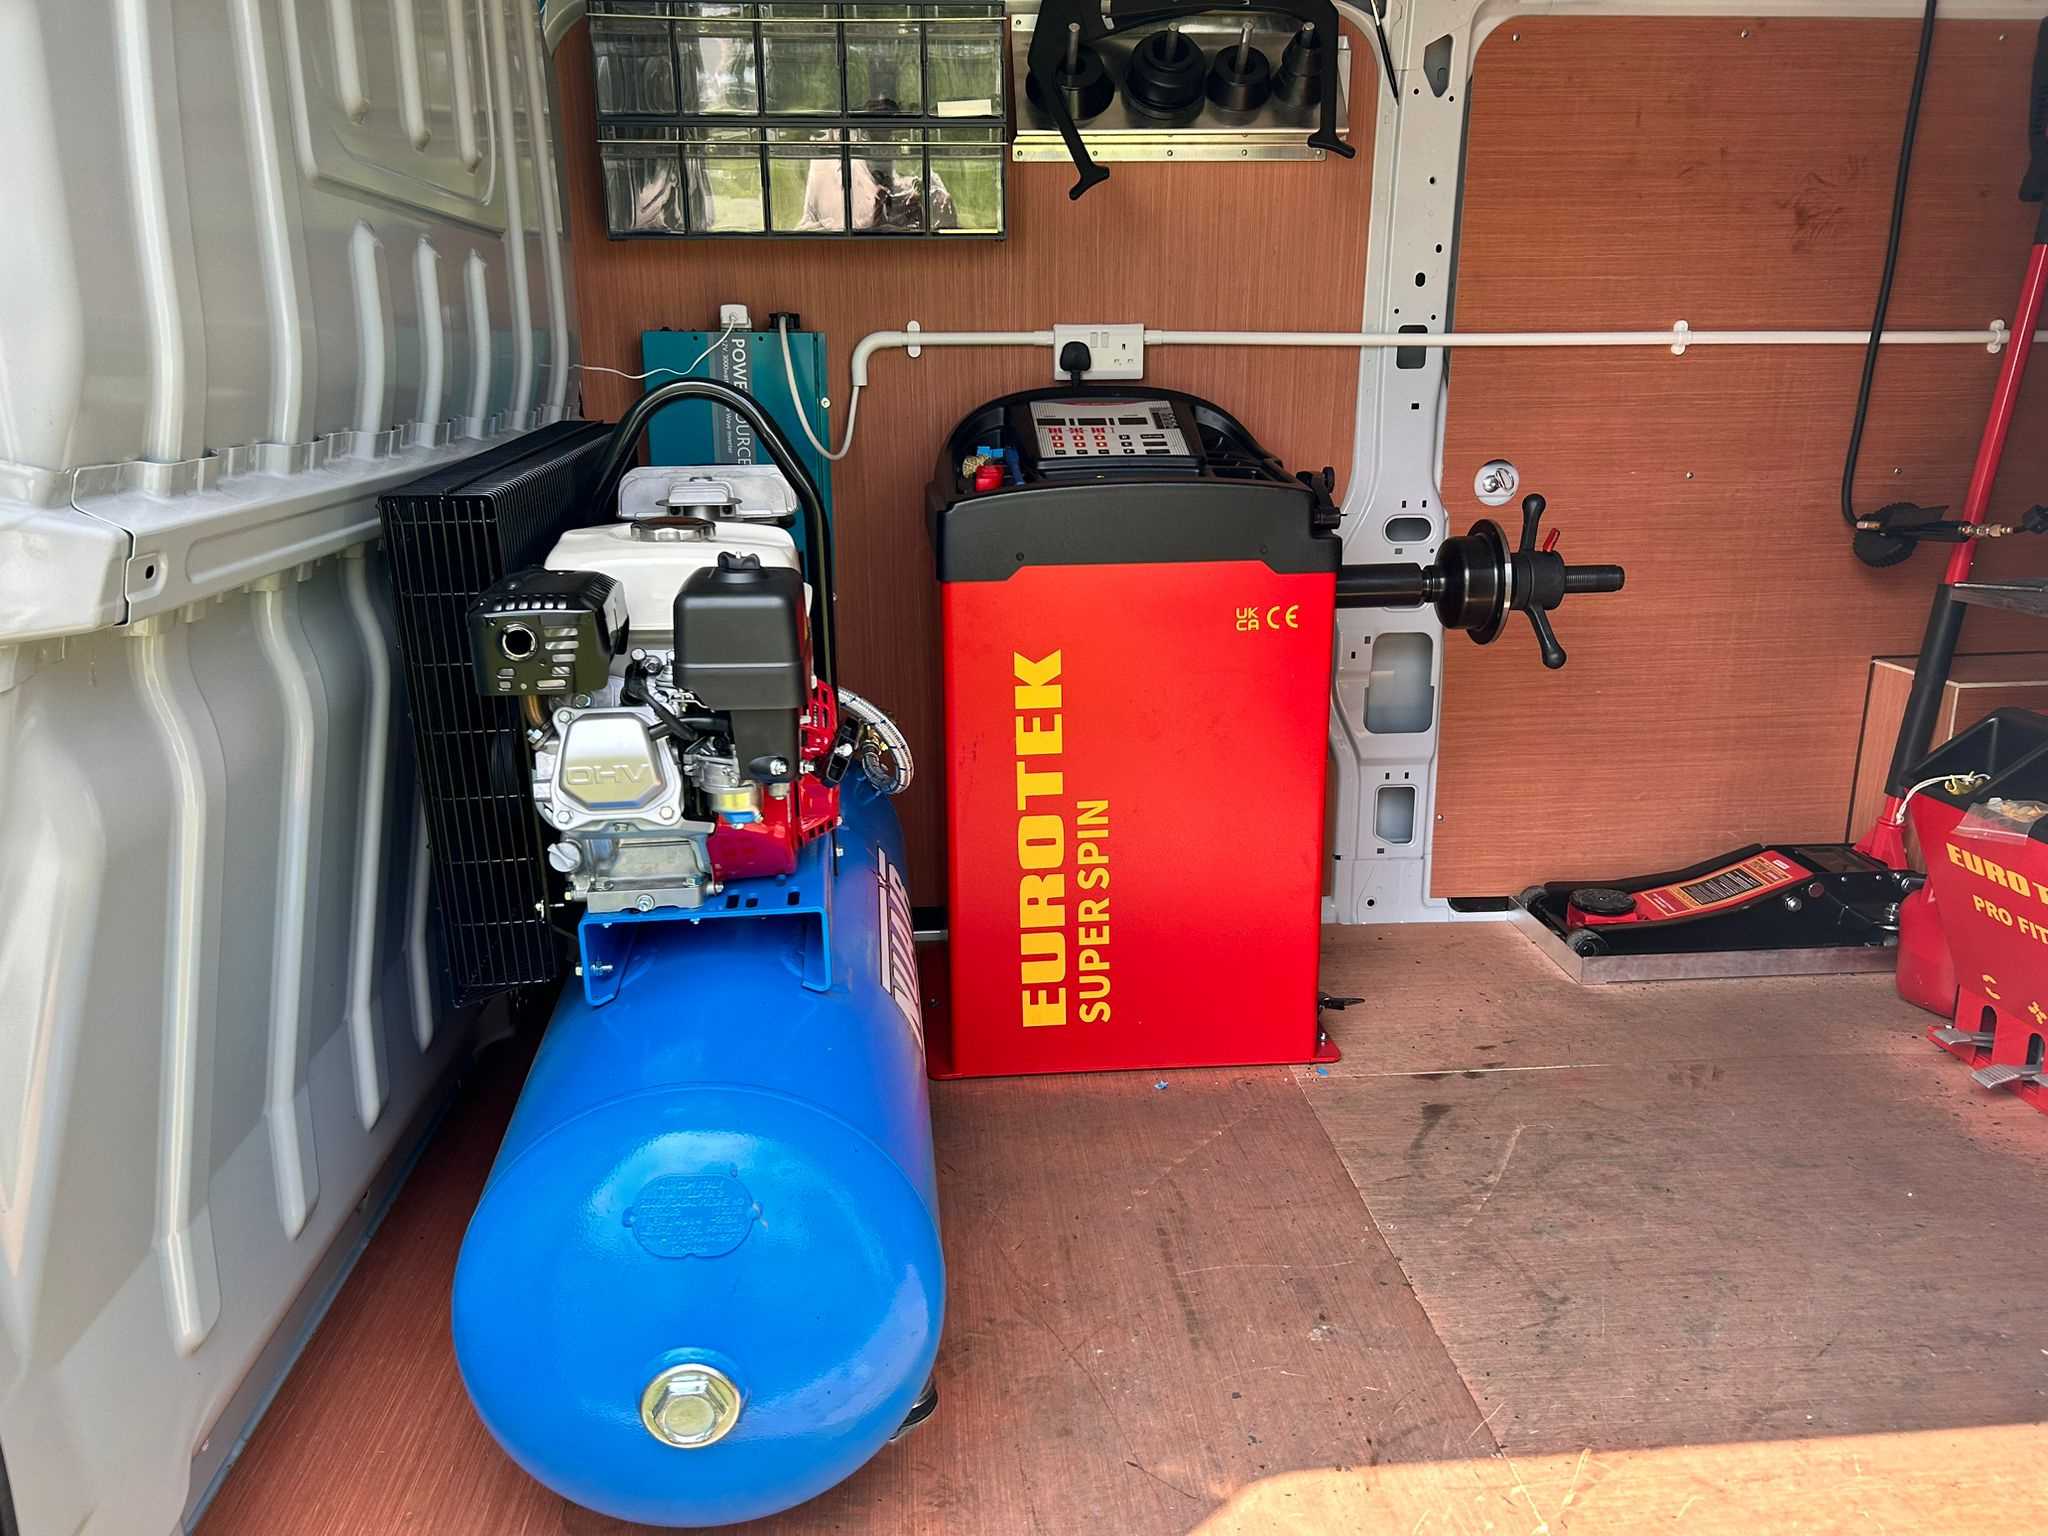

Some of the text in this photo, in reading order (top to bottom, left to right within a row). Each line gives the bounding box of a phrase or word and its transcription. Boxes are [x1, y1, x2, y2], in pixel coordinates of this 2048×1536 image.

[1235, 607, 1259, 619] UK
[1235, 619, 1260, 631] CA
[1266, 604, 1299, 629] CE
[1013, 649, 1067, 1028] EUROTEK
[1076, 799, 1111, 1023] SUPER SPIN
[1972, 894, 2014, 927] PRO
